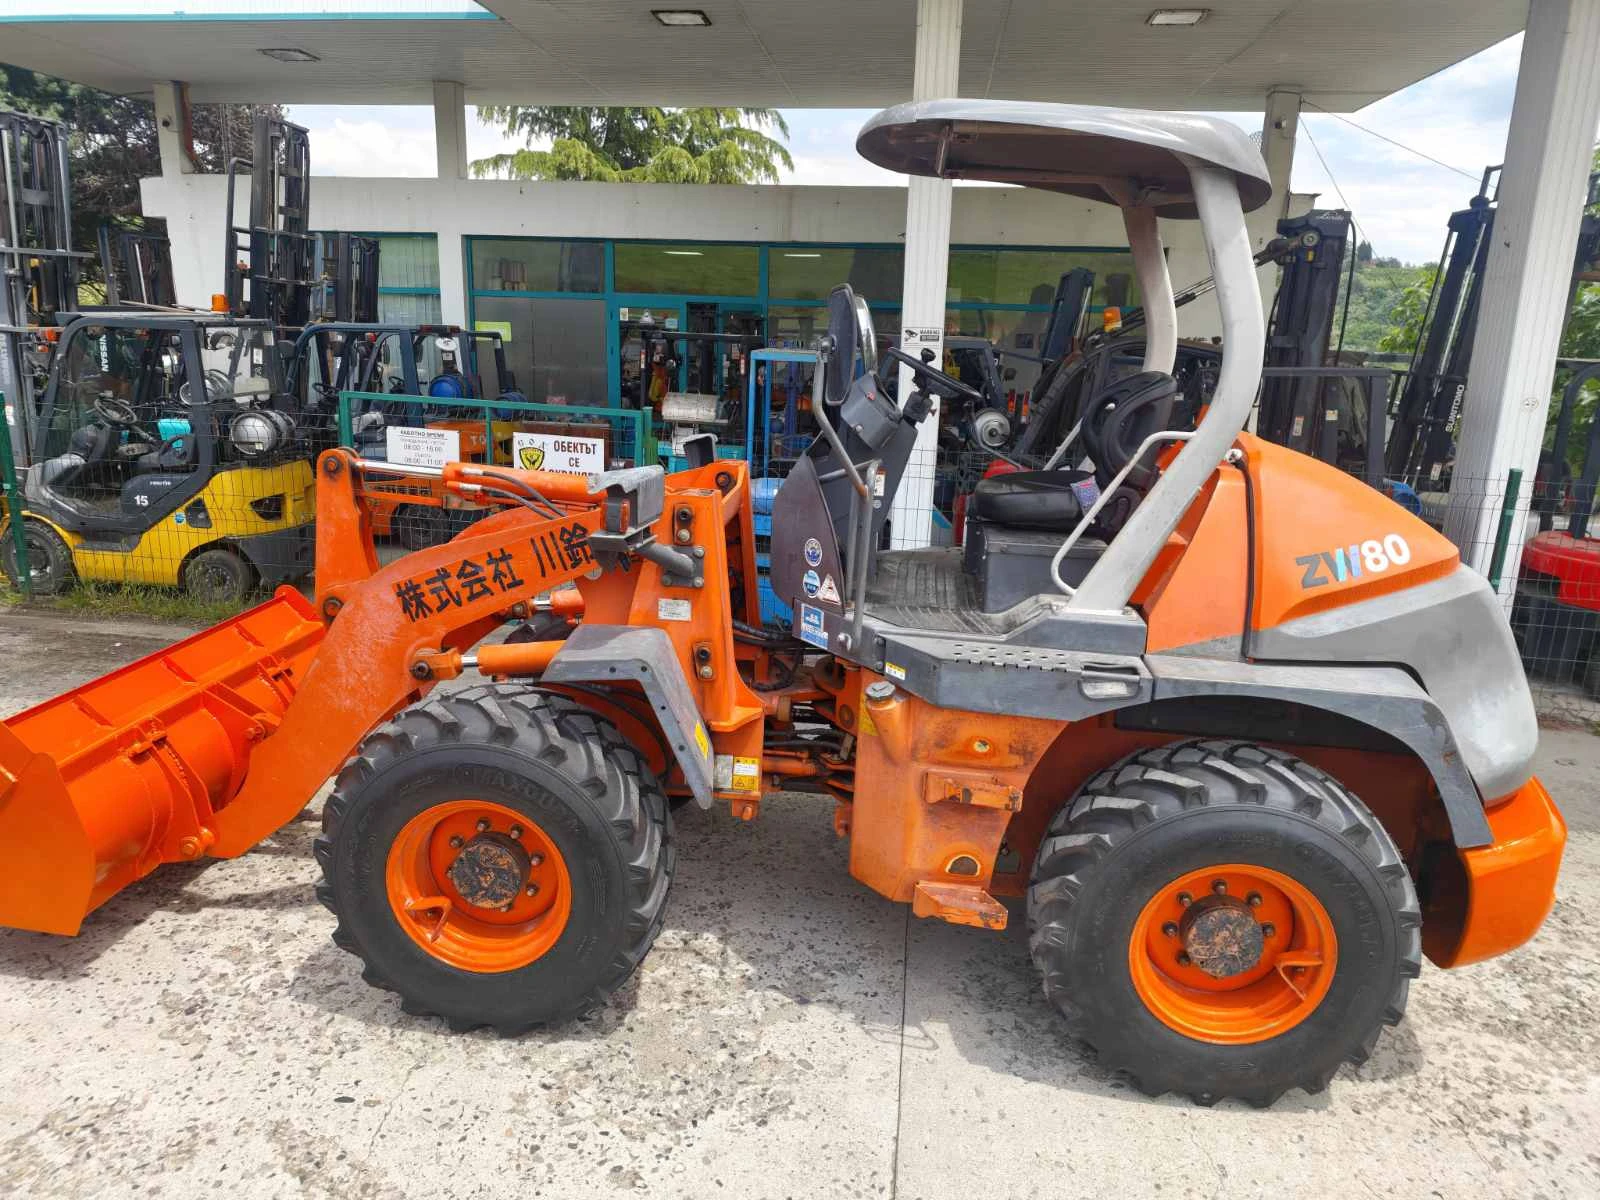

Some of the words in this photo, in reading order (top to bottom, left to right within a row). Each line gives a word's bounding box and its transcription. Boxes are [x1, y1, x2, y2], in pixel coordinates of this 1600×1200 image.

[99, 333, 109, 372] NISSAN
[553, 440, 597, 455] ОБЕКТЪТ
[568, 457, 580, 468] СЕ
[134, 495, 149, 507] 15
[1295, 533, 1411, 589] ZW80
[396, 547, 524, 623] 株式会社
